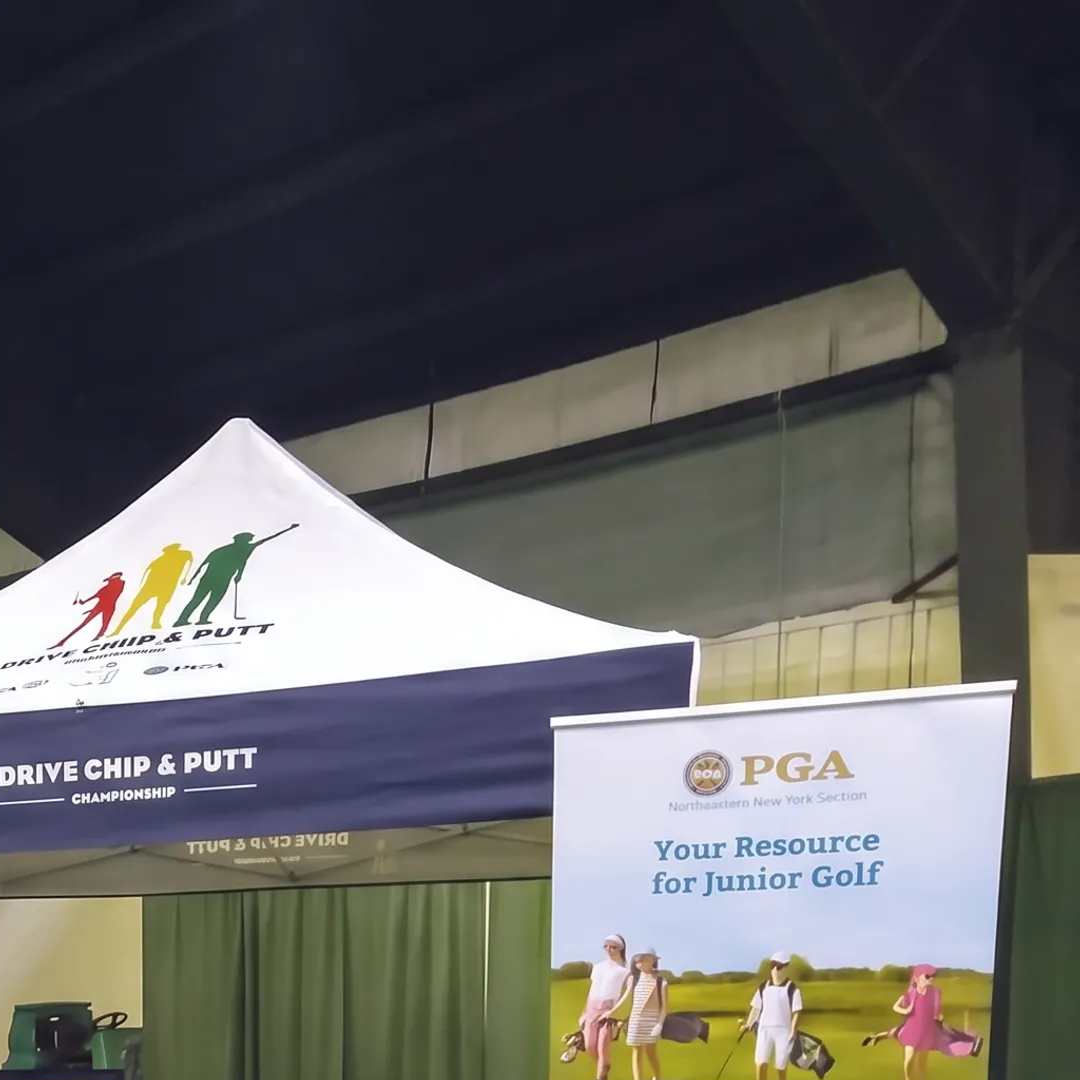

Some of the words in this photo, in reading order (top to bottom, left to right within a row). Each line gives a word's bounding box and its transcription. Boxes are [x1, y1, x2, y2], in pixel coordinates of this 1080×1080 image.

[0, 649, 78, 670] DRIVE
[163, 632, 183, 643] &
[191, 623, 275, 640] PUTT
[83, 755, 151, 781] CHIP
[157, 753, 177, 775] &
[183, 746, 258, 773] PUTT
[739, 750, 855, 786] PGA
[70, 786, 177, 805] CHAMPIONSHIP
[785, 793, 813, 805] York
[818, 790, 867, 804] Section
[654, 838, 727, 861] Your
[734, 832, 880, 858] Resource
[652, 871, 696, 895] for
[703, 866, 802, 897] Junior
[812, 860, 884, 888] Golf
